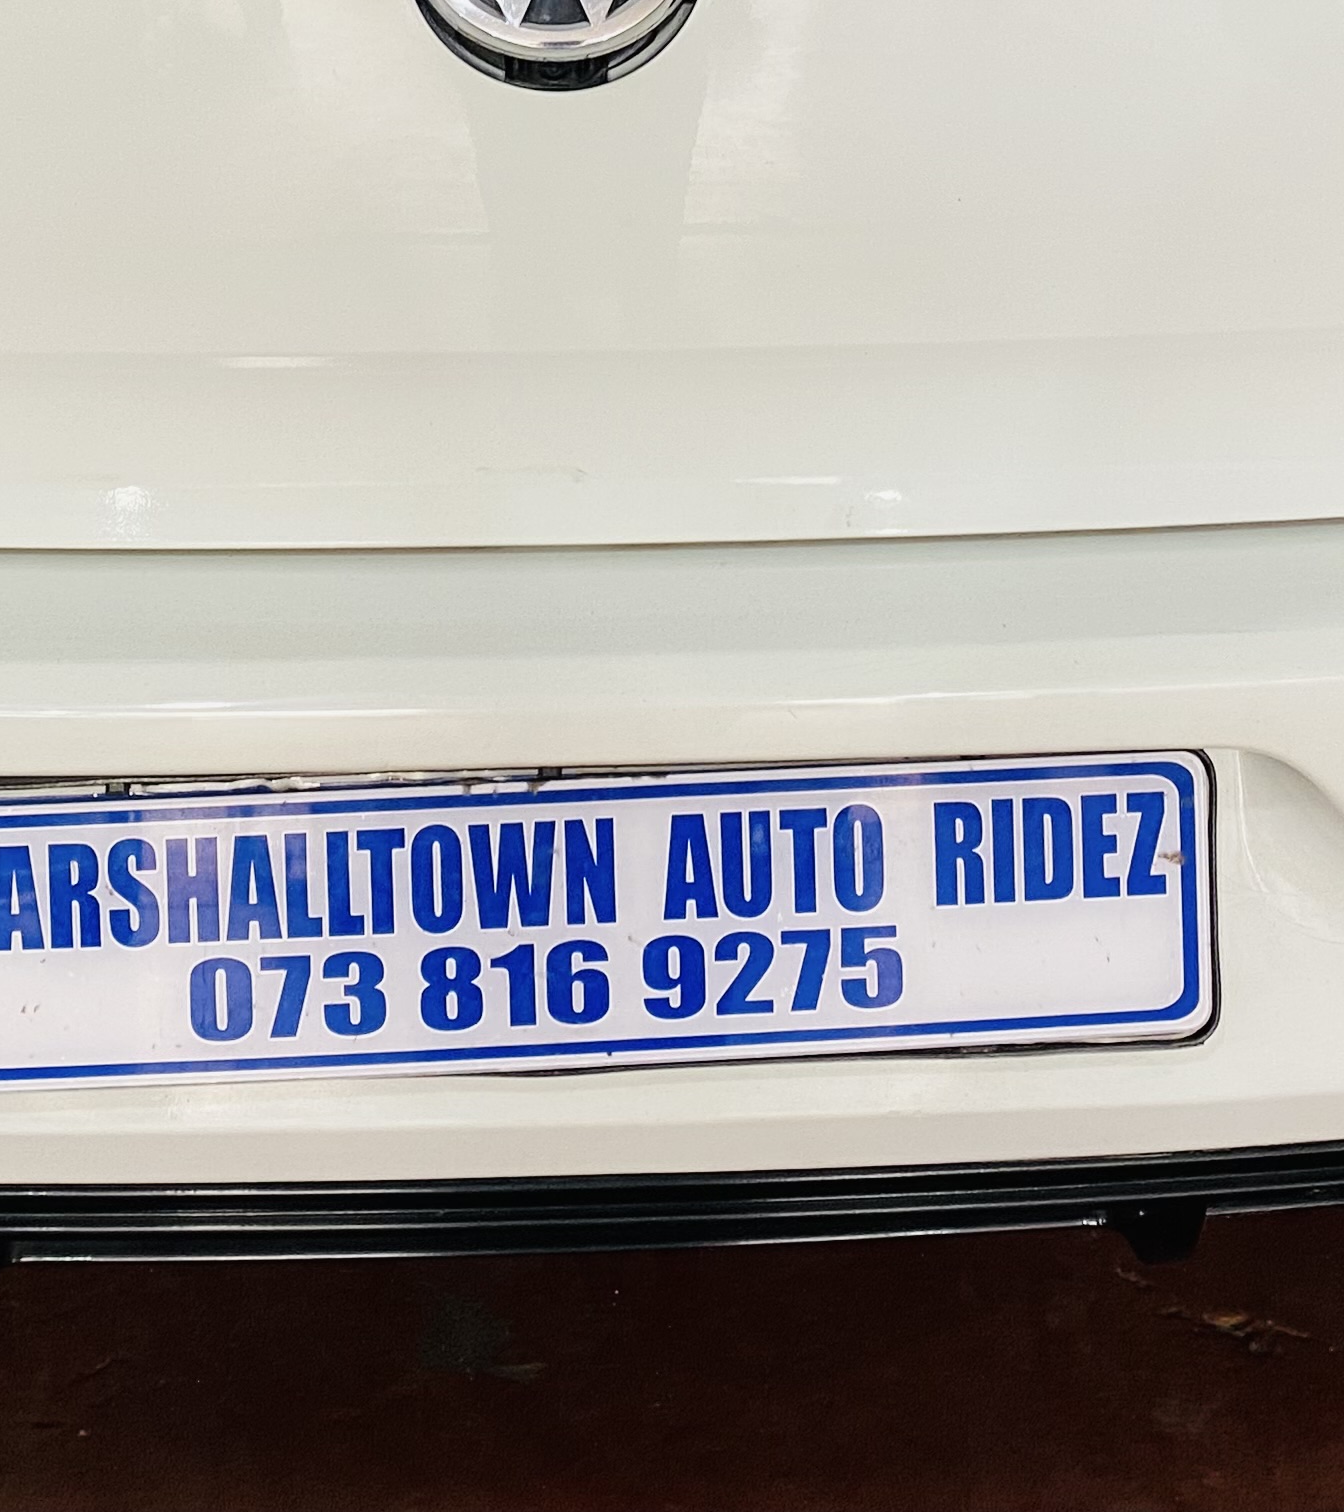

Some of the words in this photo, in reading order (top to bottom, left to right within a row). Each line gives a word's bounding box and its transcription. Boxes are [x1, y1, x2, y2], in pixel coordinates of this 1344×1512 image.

[662, 803, 887, 921] AUTO
[932, 790, 1168, 908] RIDEZ
[189, 950, 387, 1043] 073
[419, 937, 611, 1032] 816
[641, 924, 905, 1021] 9275
